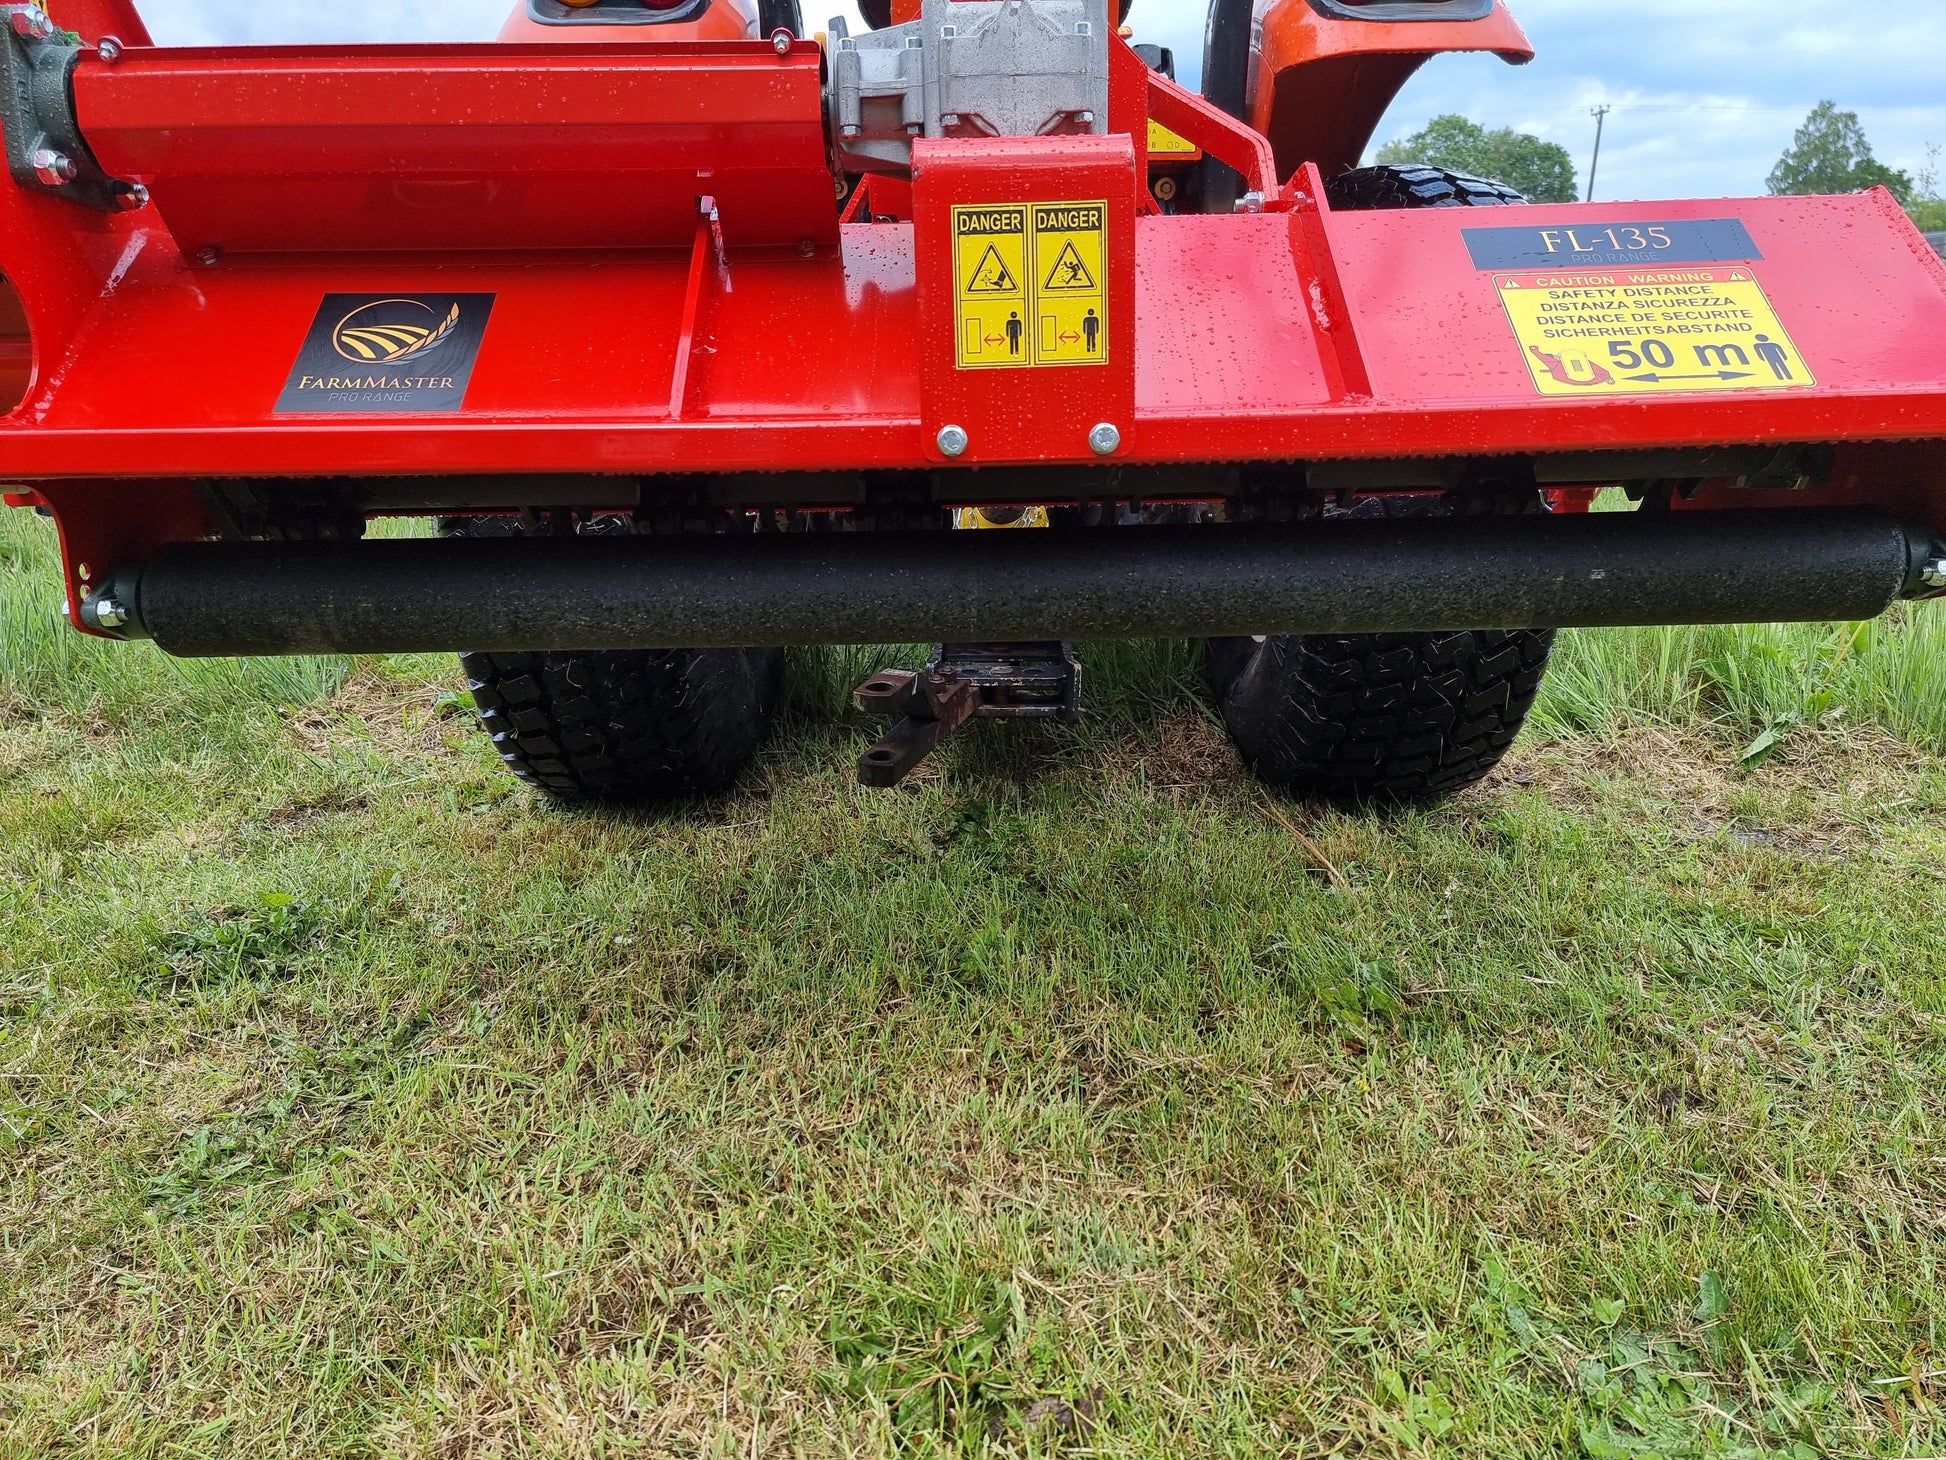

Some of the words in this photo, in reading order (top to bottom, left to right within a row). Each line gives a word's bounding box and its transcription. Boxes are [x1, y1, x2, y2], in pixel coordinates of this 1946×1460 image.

[959, 213, 1022, 232] DANGER
[1037, 210, 1099, 229] DANGER
[1538, 226, 1672, 253] FL-135
[1571, 253, 1603, 263] PRO
[1607, 251, 1660, 263] RANGE
[1536, 275, 1615, 287] CAUTION
[1628, 272, 1714, 284] WARNING
[1549, 288, 1616, 300] SAFETY
[1623, 285, 1713, 297] DISTANCE
[1540, 300, 1630, 312] DISTANZA
[1633, 297, 1736, 309] SICUREZZA
[1536, 313, 1627, 325] DISTANCE
[1631, 312, 1658, 322] DE
[1661, 309, 1754, 321] SECURITE
[1543, 322, 1753, 338] SICHERHEITSABSTAND
[1608, 338, 1675, 370] 50
[1692, 343, 1751, 367] m
[328, 391, 358, 402] PRO
[361, 391, 413, 402] RANGE
